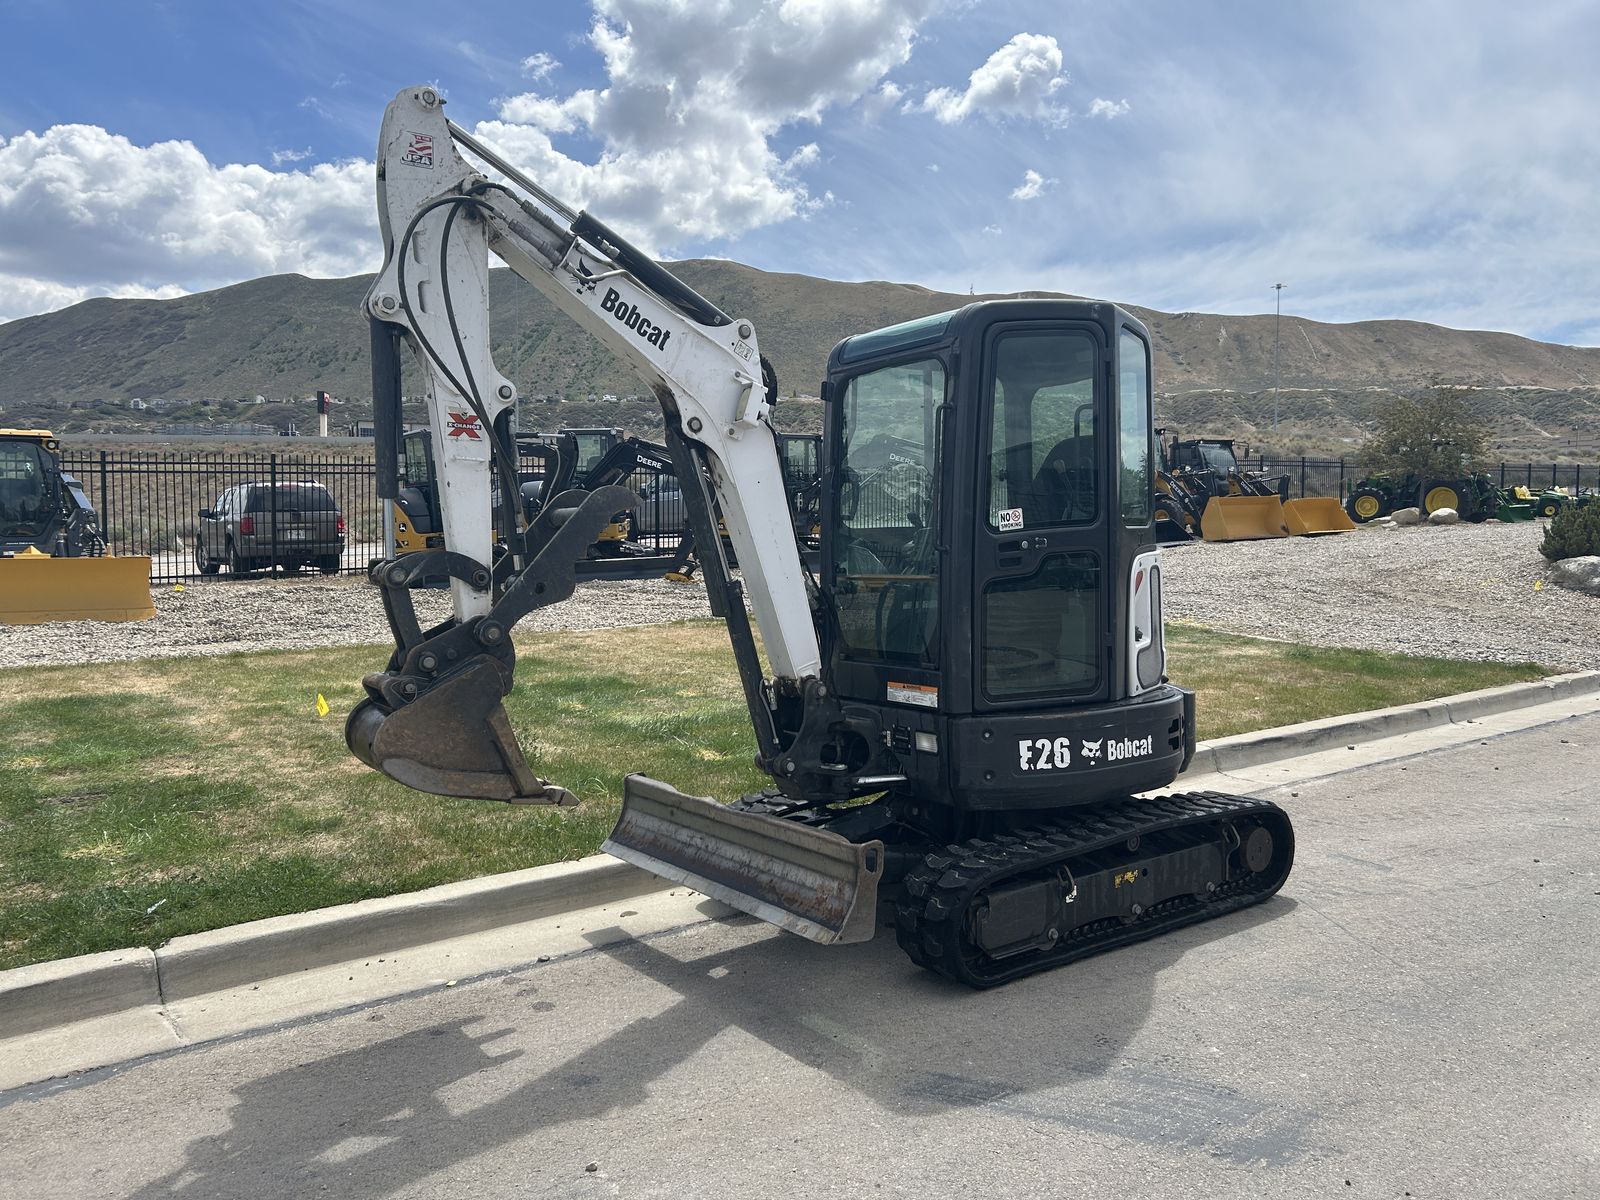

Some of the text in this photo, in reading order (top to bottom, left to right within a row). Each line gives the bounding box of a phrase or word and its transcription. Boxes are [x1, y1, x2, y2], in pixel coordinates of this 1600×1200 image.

[600, 286, 671, 352] Bobcat
[636, 454, 663, 470] DEERE
[889, 453, 915, 466] DEERE
[1000, 512, 1011, 522] NO
[1000, 521, 1022, 529] SMOKING
[1107, 735, 1153, 761] Bobcat
